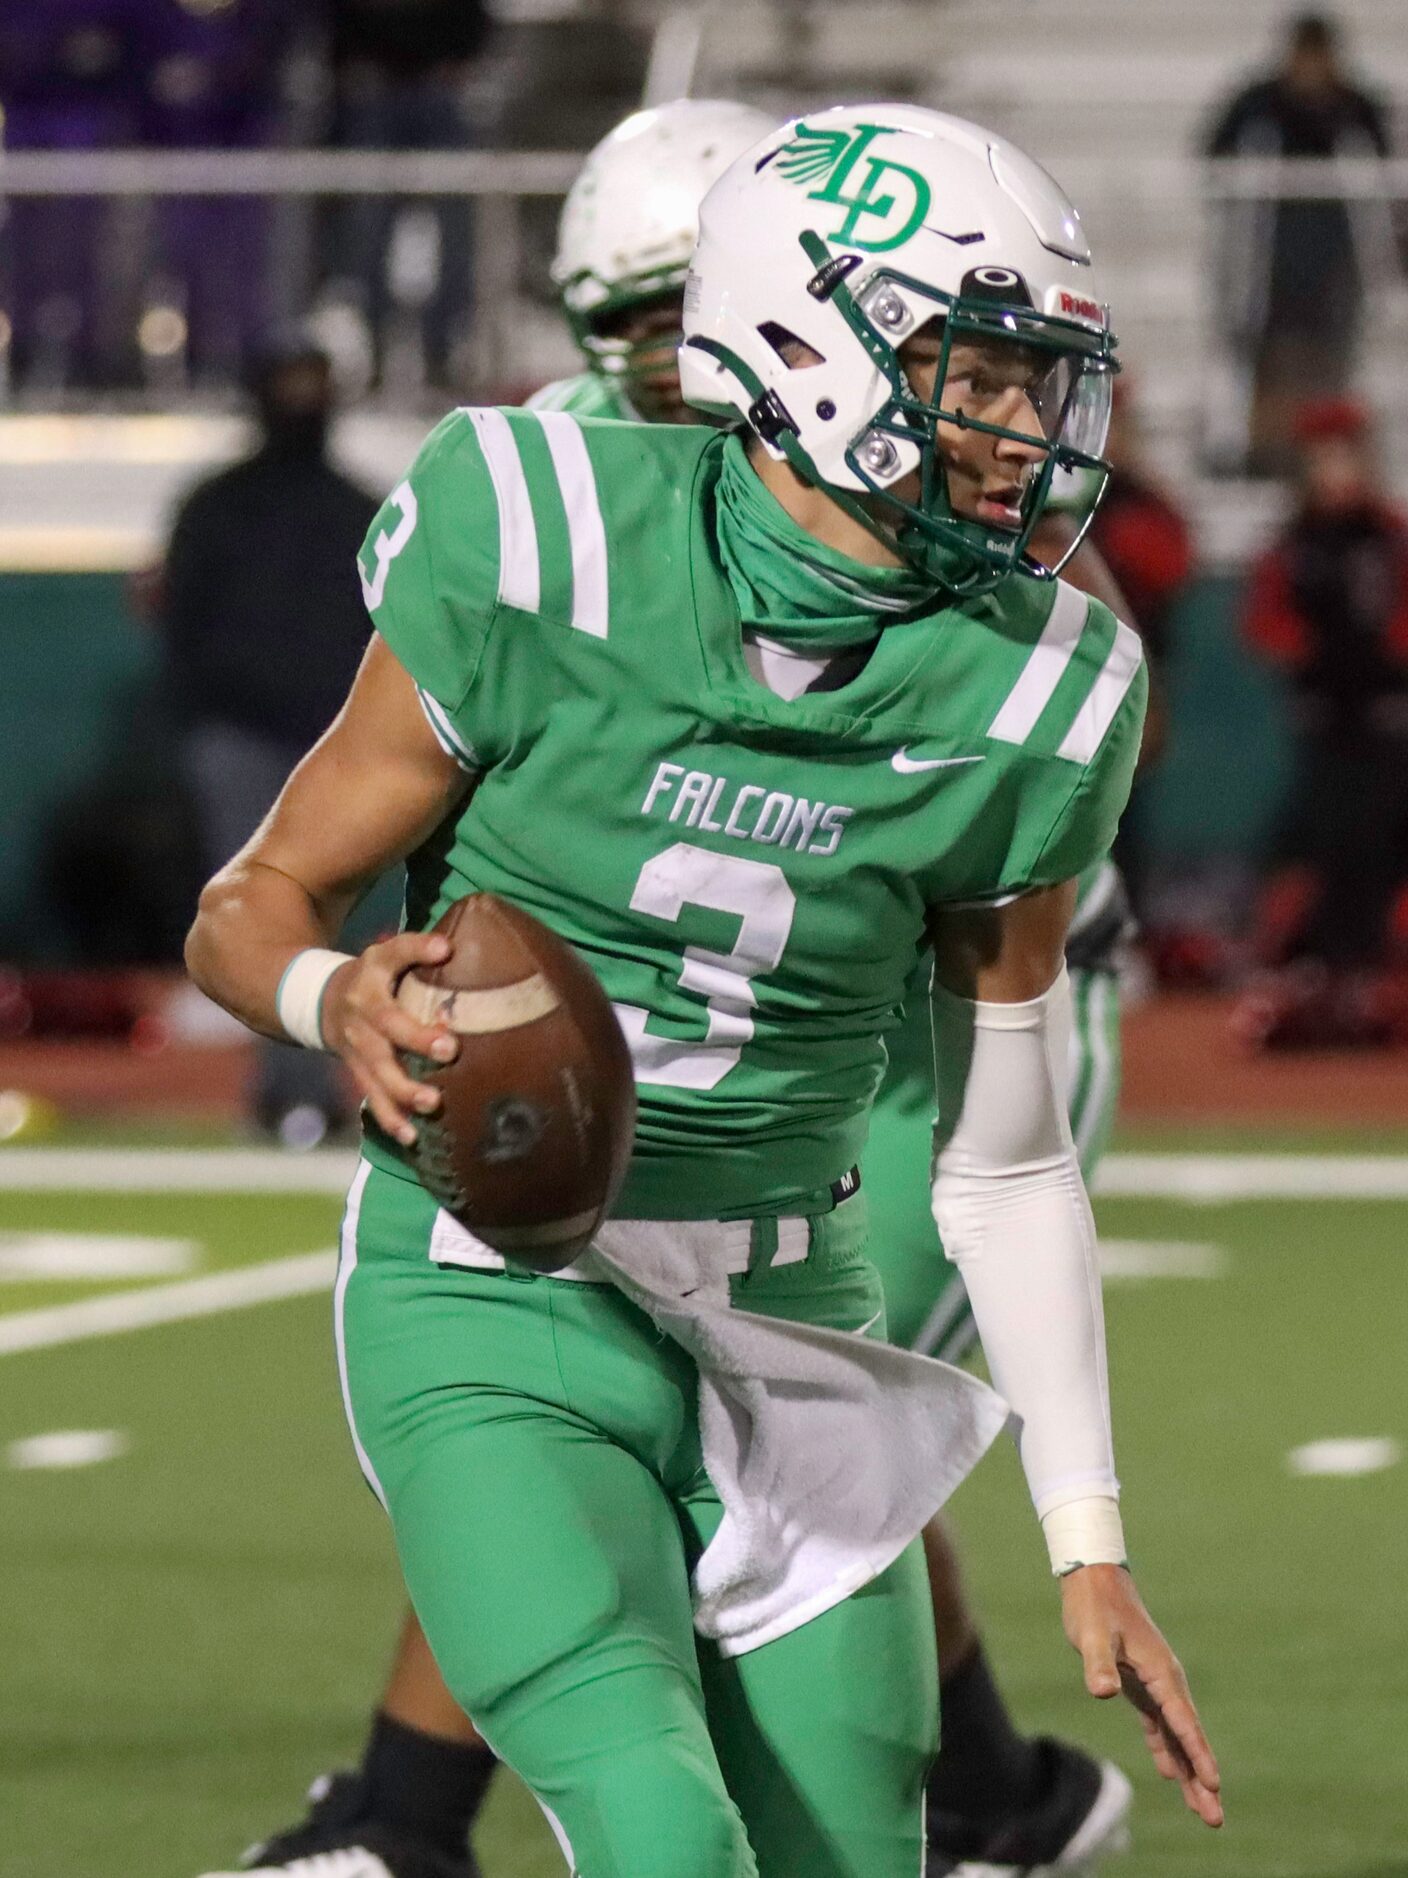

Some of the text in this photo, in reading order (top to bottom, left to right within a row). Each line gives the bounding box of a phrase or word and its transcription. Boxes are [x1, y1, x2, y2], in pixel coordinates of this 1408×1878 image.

[357, 479, 418, 613] 3
[641, 761, 855, 857] FALCONS
[612, 842, 797, 1090] 3
[840, 1170, 854, 1192] M
